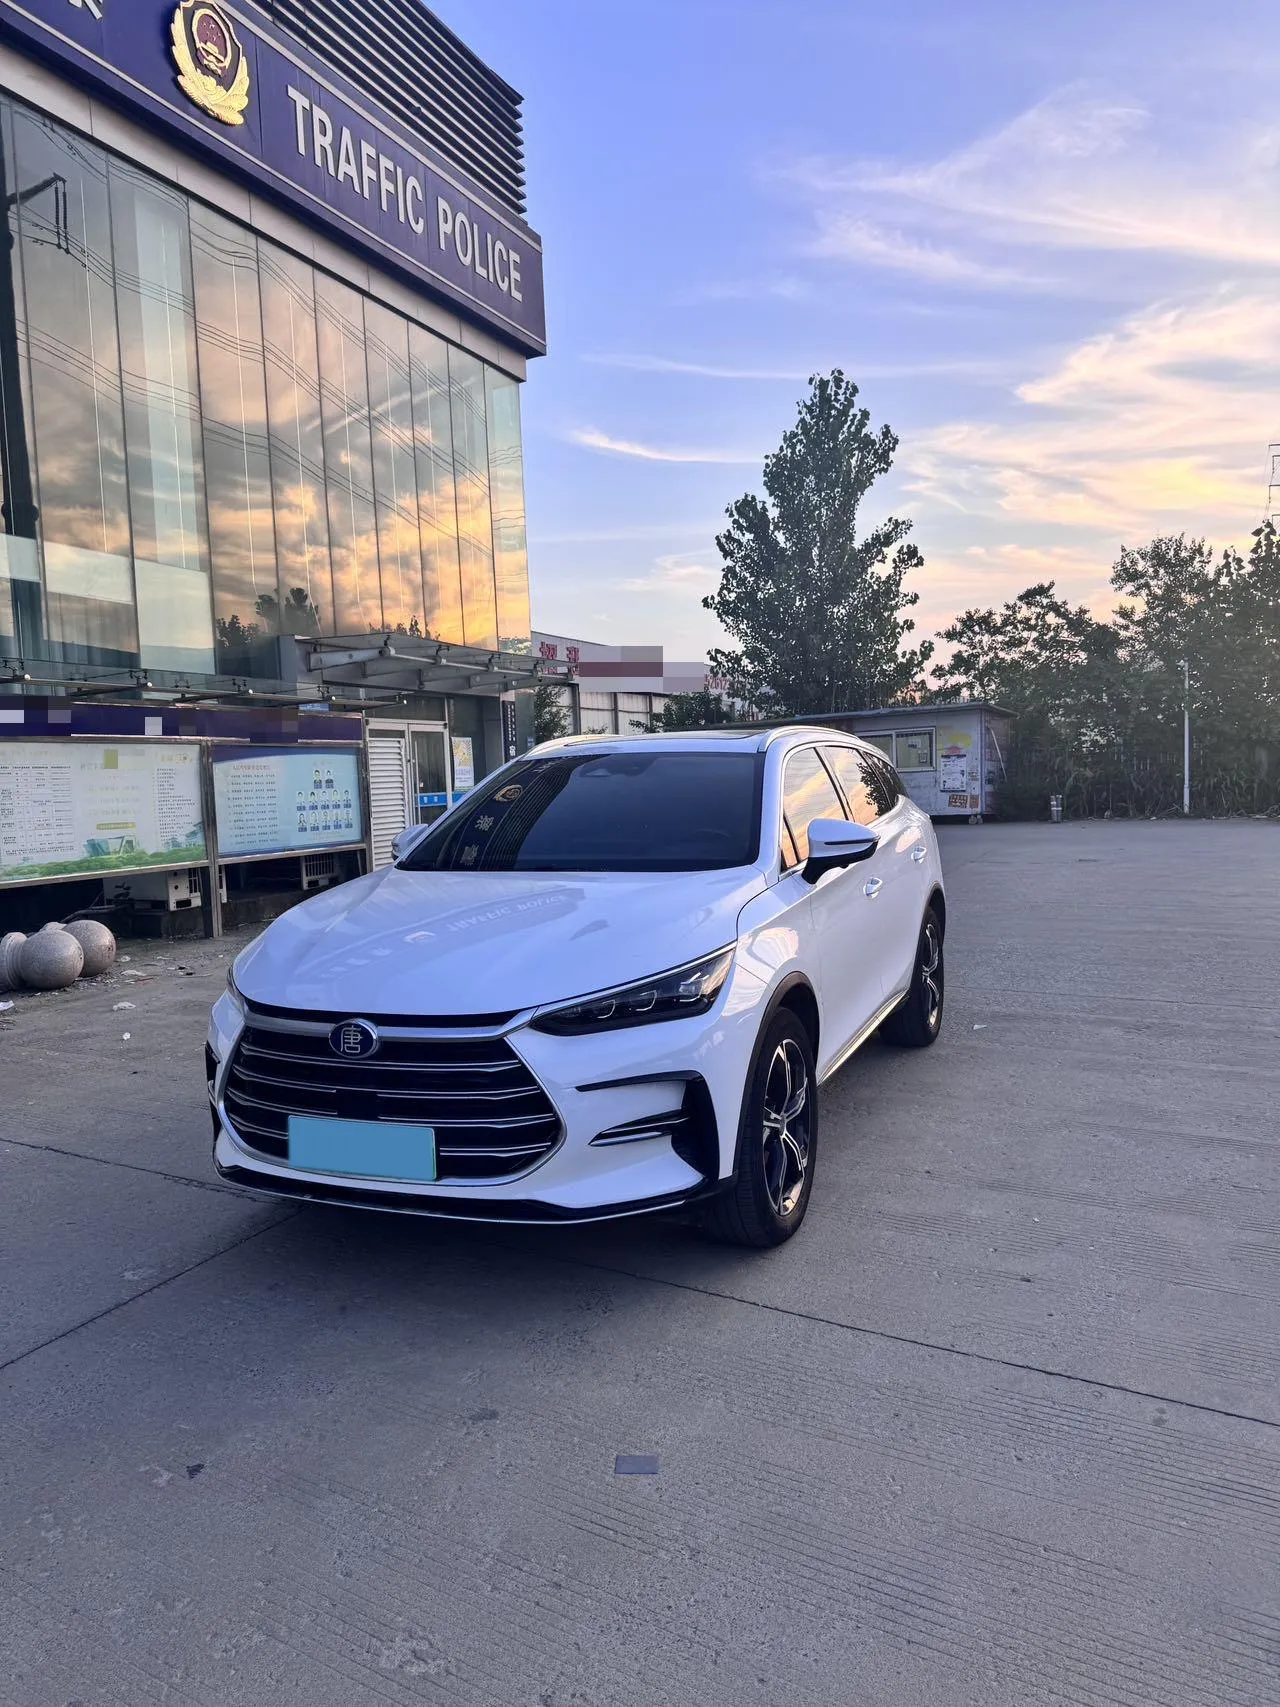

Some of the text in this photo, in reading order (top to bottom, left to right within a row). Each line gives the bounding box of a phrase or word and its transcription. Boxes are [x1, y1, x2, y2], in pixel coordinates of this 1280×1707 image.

[286, 85, 523, 302] TRAFFIC POLICE
[340, 1025, 364, 1054] 唐
